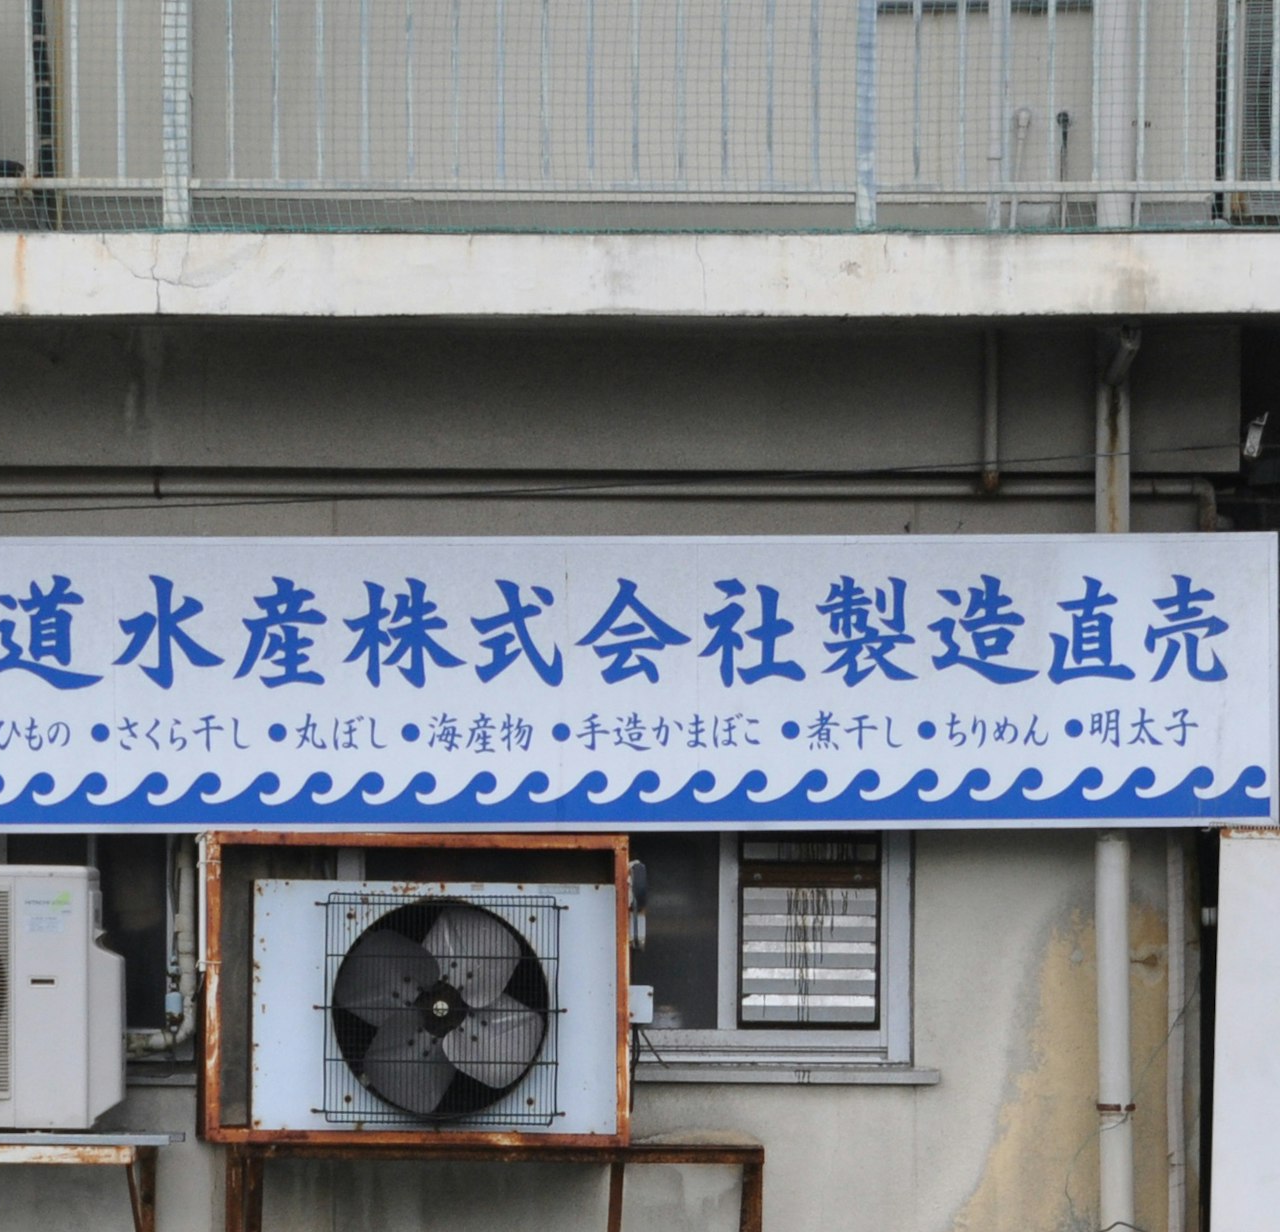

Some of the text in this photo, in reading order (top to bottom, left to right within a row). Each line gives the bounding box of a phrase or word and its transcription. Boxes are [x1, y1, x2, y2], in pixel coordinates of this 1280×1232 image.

[117, 713, 251, 753] さくら干し
[294, 713, 389, 751] 丸ぼし
[427, 711, 534, 754] 海産物
[576, 711, 763, 754] 手造かまぼこ
[807, 710, 903, 751] 煮干し
[945, 712, 1050, 750] ちりめん
[1088, 706, 1199, 750] 明太子
